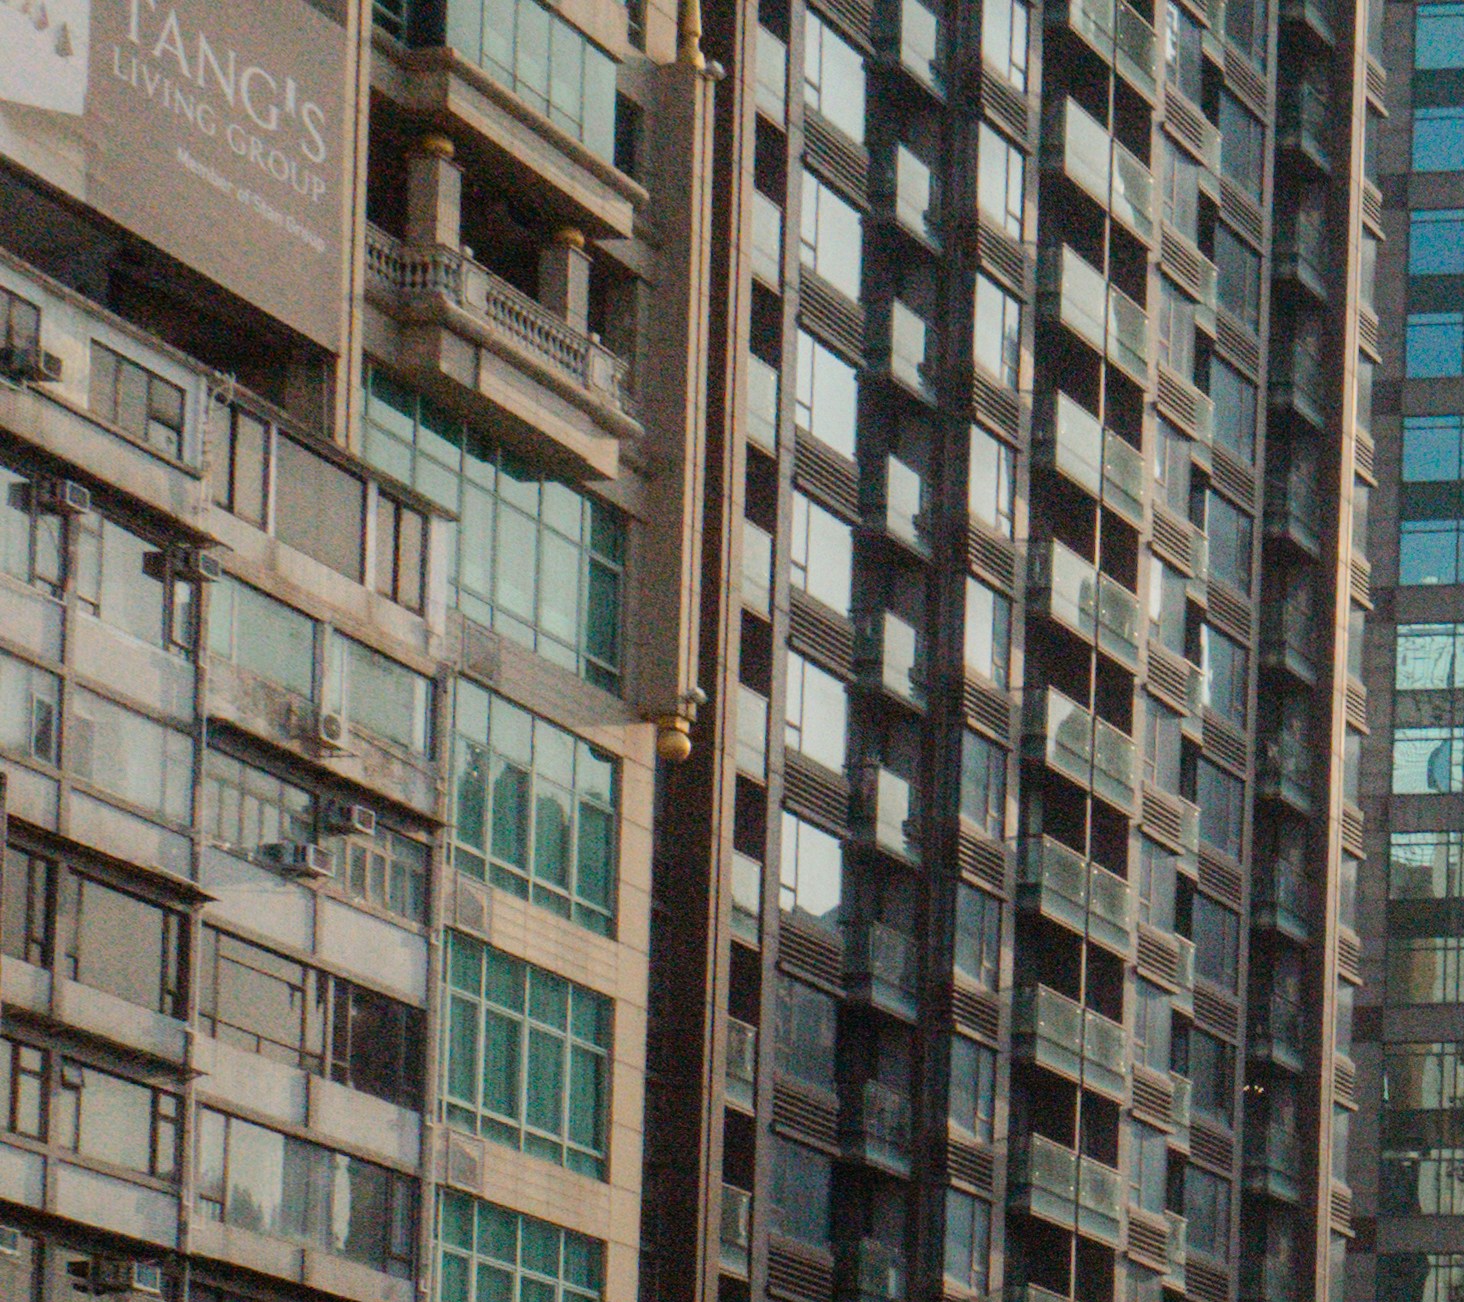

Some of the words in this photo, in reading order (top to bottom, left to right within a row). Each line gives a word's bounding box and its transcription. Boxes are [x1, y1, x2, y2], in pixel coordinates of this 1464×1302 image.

[114, 45, 216, 136] LIVING
[227, 124, 326, 201] GROUP
[126, 0, 326, 163] TANG'S
